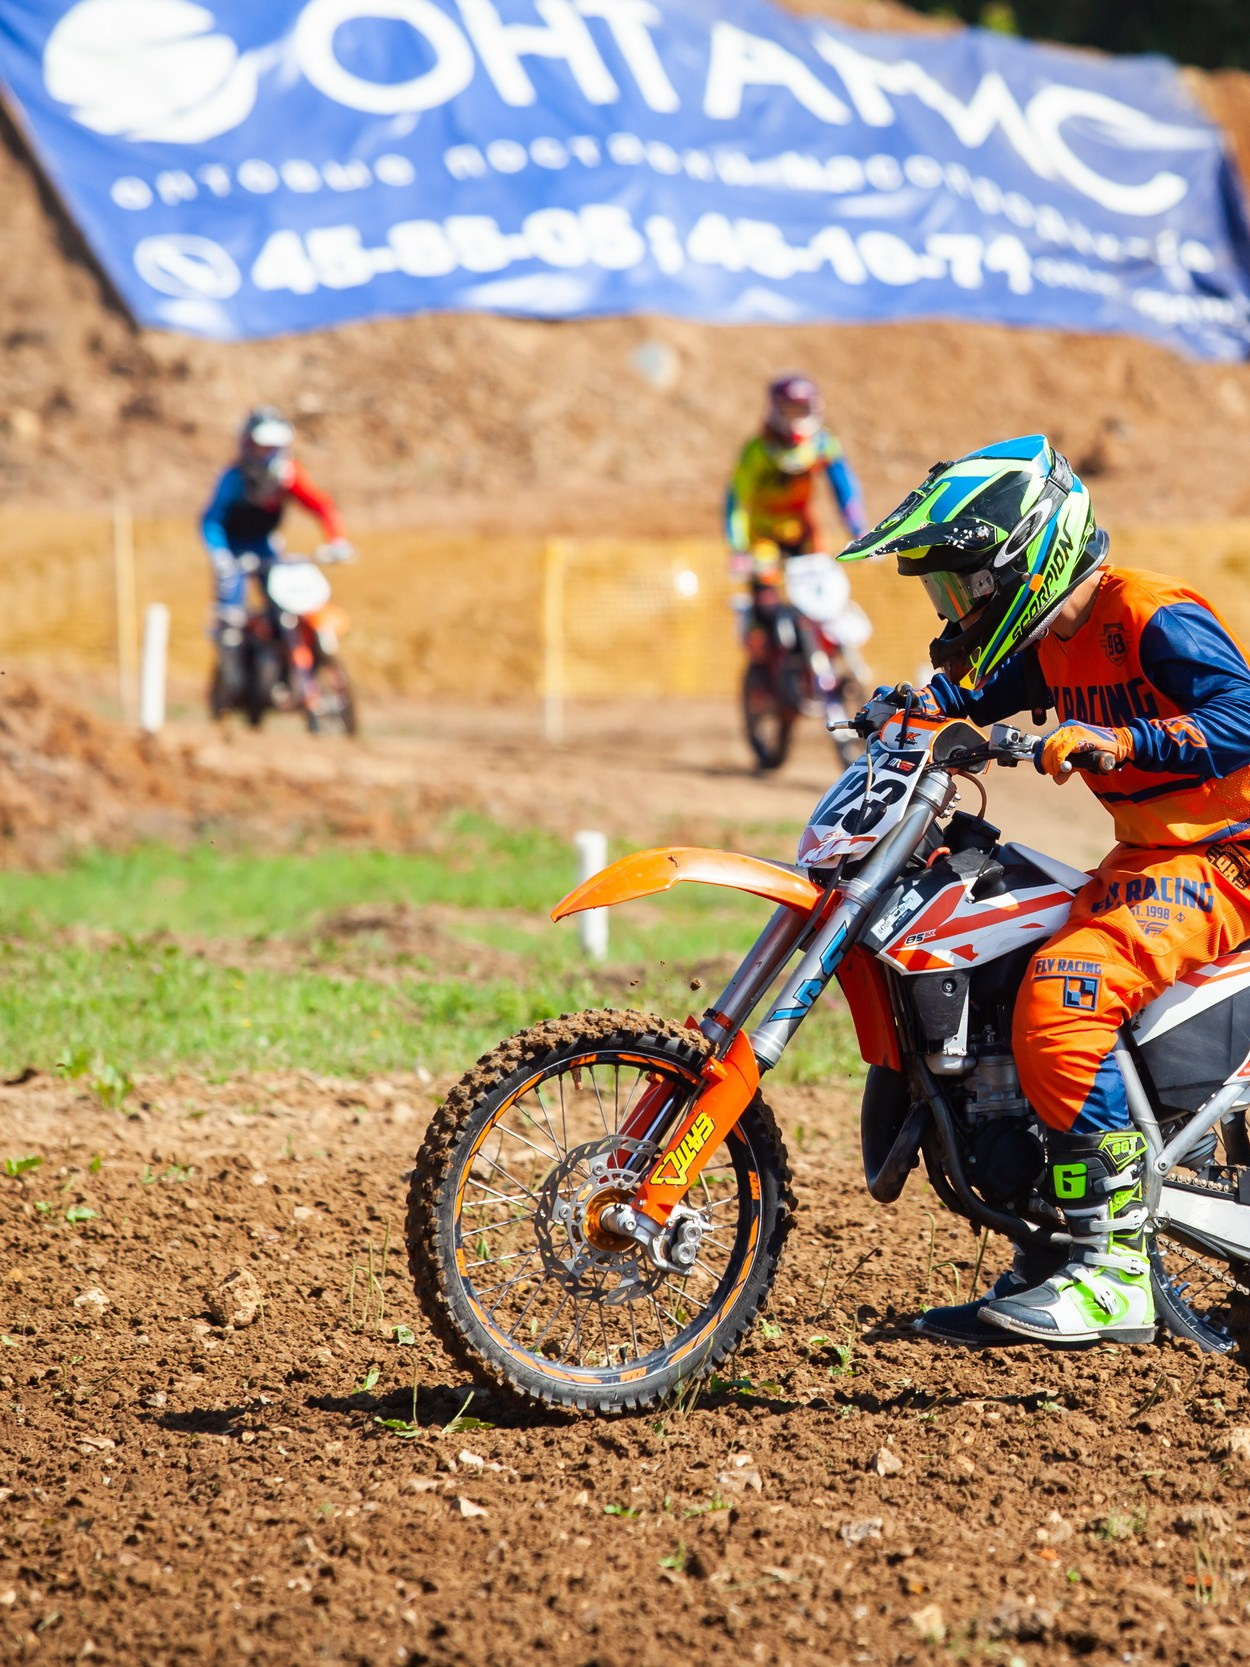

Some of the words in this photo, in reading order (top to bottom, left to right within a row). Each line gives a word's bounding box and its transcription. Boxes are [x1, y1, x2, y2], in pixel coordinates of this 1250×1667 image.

[1011, 530, 1074, 641] SCORPION
[1062, 677, 1161, 728] RACING
[807, 770, 908, 836] 123
[1216, 855, 1241, 884] 98
[1126, 877, 1215, 914] RACING
[1146, 906, 1170, 920] 1998
[1035, 958, 1054, 974] FLY
[1058, 959, 1102, 975] RACING
